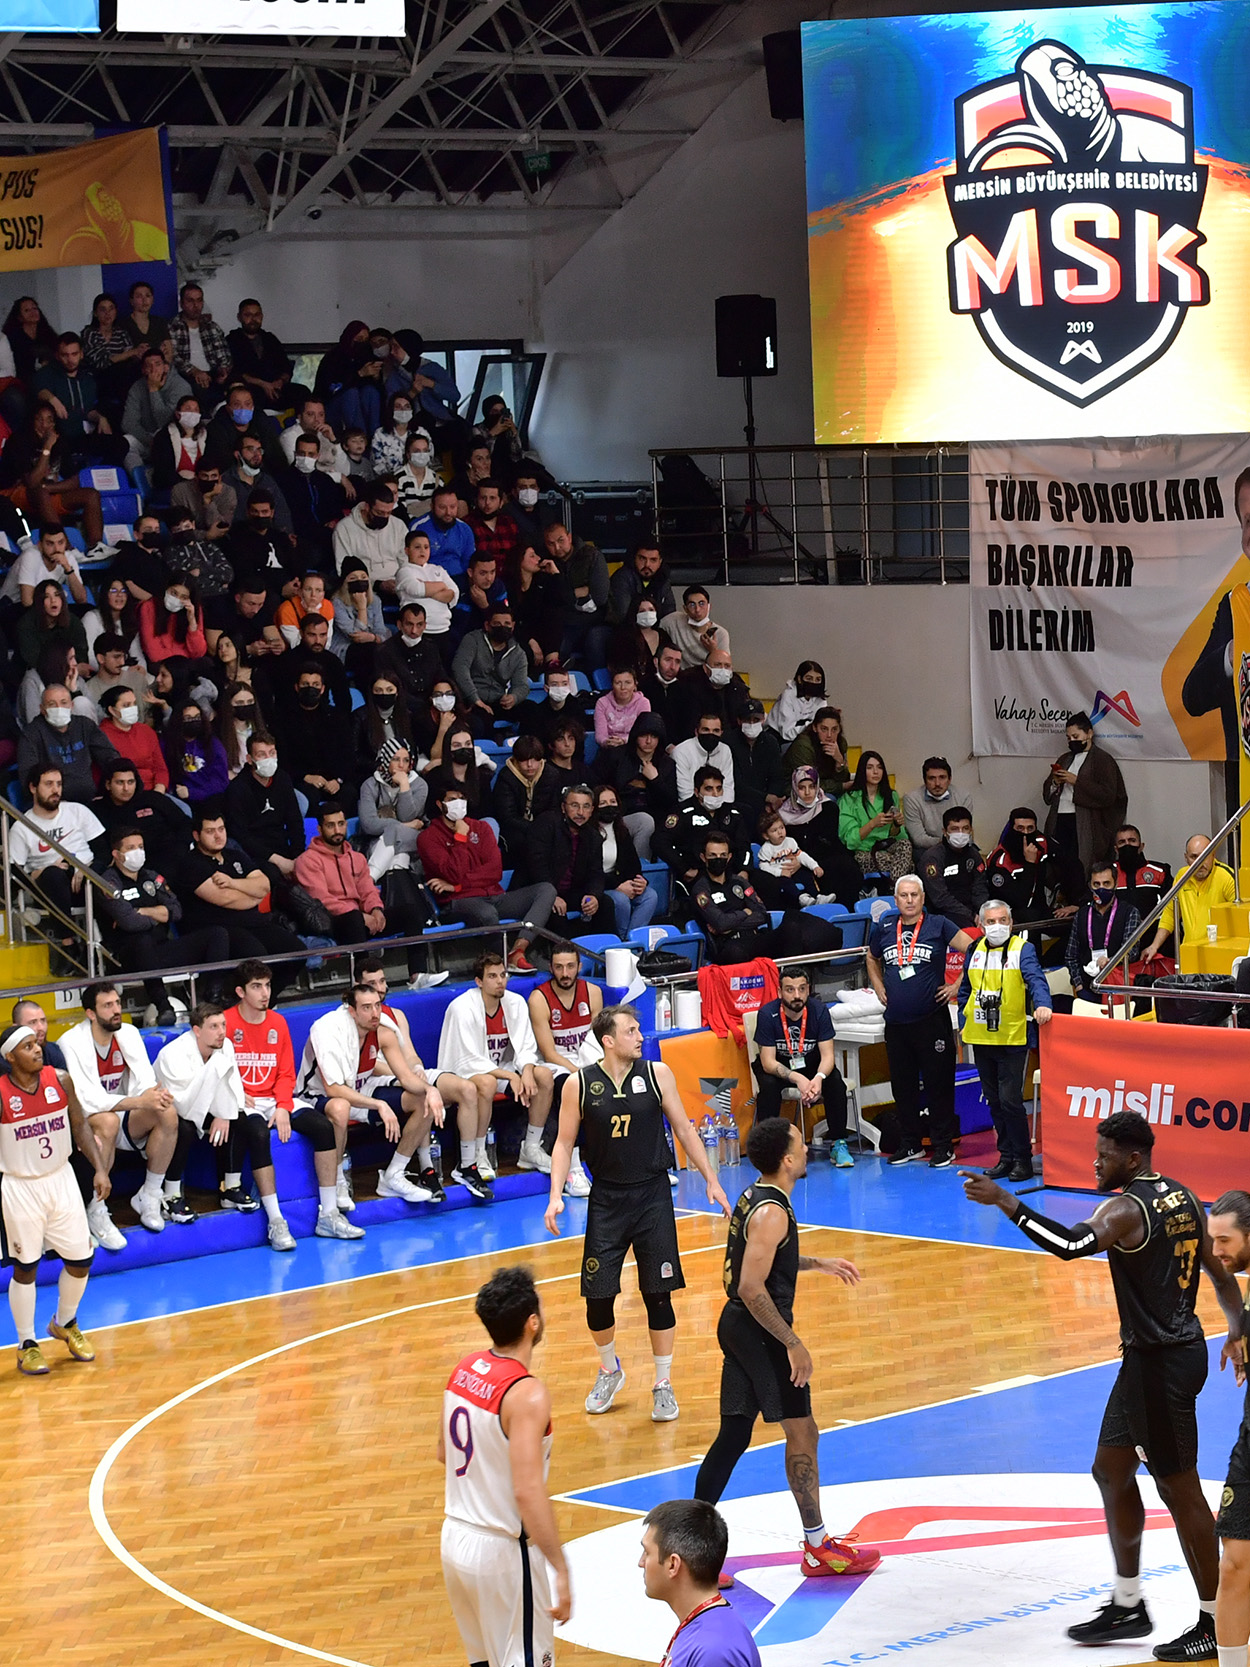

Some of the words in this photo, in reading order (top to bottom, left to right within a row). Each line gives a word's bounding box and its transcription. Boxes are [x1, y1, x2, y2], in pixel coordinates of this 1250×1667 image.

[954, 175, 1011, 202] MERSİN
[1016, 169, 1110, 193] BÜYÜKŞEHİR
[1115, 169, 1198, 193] BELEDİYESİ
[954, 202, 1201, 310] MSK
[1066, 321, 1094, 334] 2019
[985, 475, 1041, 522] TÜM
[1047, 477, 1225, 523] SPORCULARA
[987, 544, 1134, 592] BAŞARILAR
[988, 605, 1096, 652] DİLERİM
[994, 695, 1036, 731] Vahap
[47, 827, 64, 840] IKE
[14, 1118, 48, 1141] MERSİN
[48, 1116, 65, 1132] MSK
[611, 1114, 631, 1138] 27
[38, 1137, 53, 1159] 3
[449, 1405, 474, 1477] 9
[884, 1616, 1006, 1653] MERSİN
